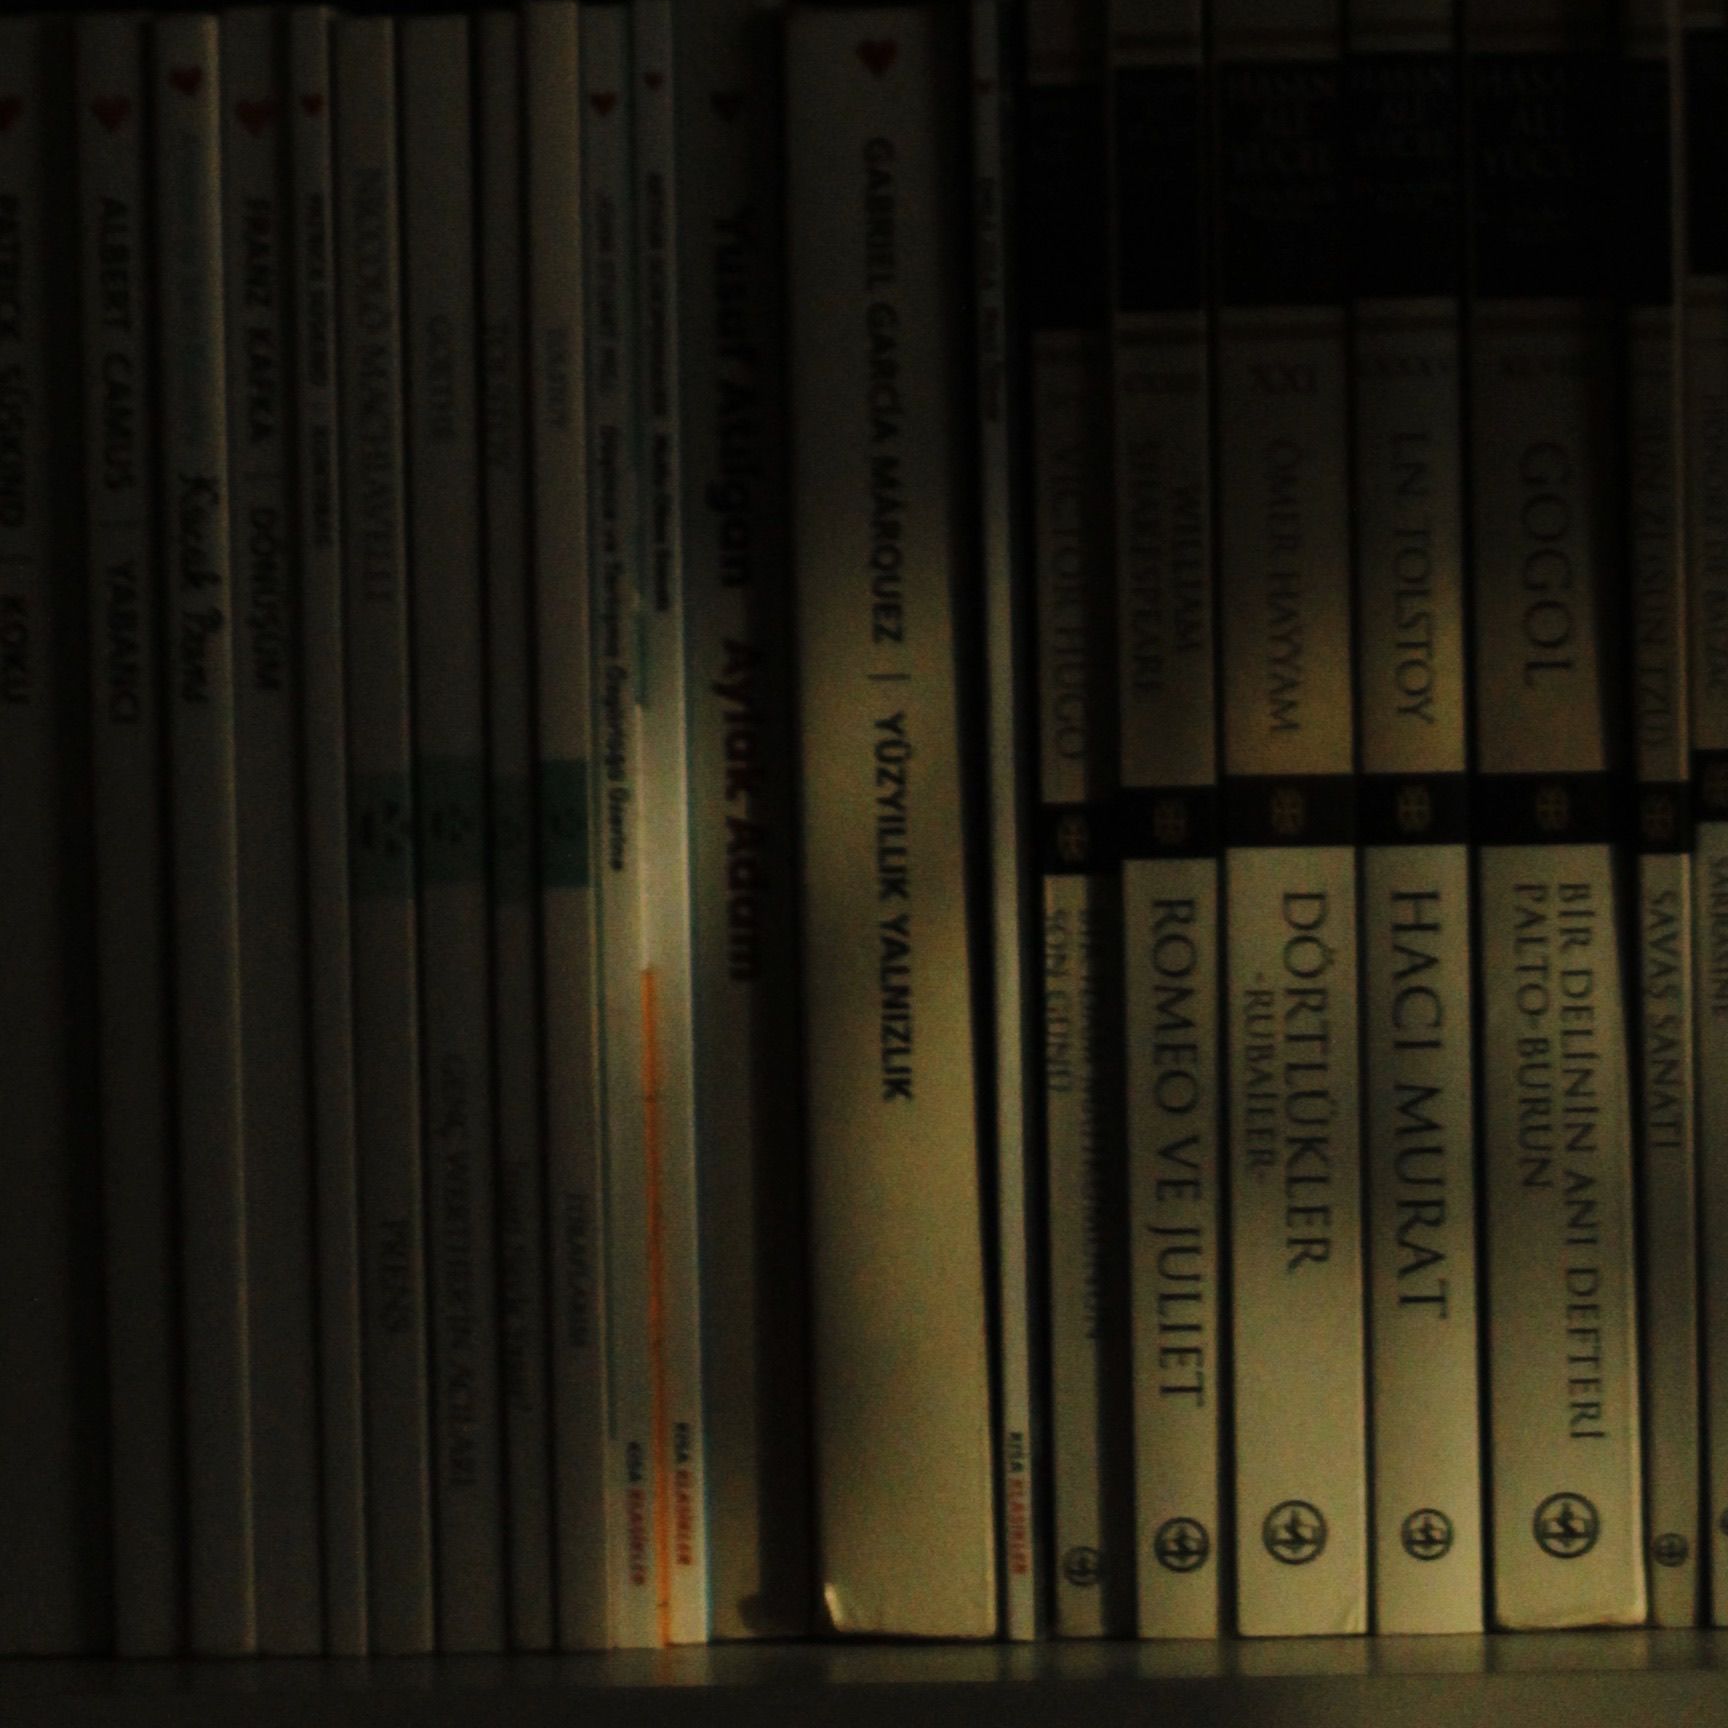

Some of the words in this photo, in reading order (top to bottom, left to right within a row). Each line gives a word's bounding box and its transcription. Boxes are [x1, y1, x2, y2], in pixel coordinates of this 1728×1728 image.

[99, 194, 133, 333] ALBERT
[244, 194, 276, 308] FRANZ
[713, 206, 758, 359] Yusuf
[862, 136, 896, 291] GABRIEL
[101, 351, 133, 493] CAMUS
[246, 327, 276, 442] KAFKA
[705, 377, 759, 589] Atılgan
[1521, 440, 1576, 687] GOGOL
[1399, 523, 1440, 726] TOLSTOY
[711, 636, 763, 802] Aylak
[871, 711, 915, 902] YÜZYILLIK
[728, 815, 769, 981] Adam
[1390, 889, 1441, 1051] HACI
[879, 913, 913, 1103] YALNIZLIK
[1149, 895, 1199, 1118] ROMEO
[1282, 889, 1337, 1276] DÖRTLÜKLER
[1157, 1132, 1202, 1202] VE
[1396, 1081, 1445, 1321] MURAT
[1563, 1168, 1599, 1247] ANI
[1150, 1224, 1207, 1406] JULIET
[1565, 1265, 1607, 1441] DEFTERİ
